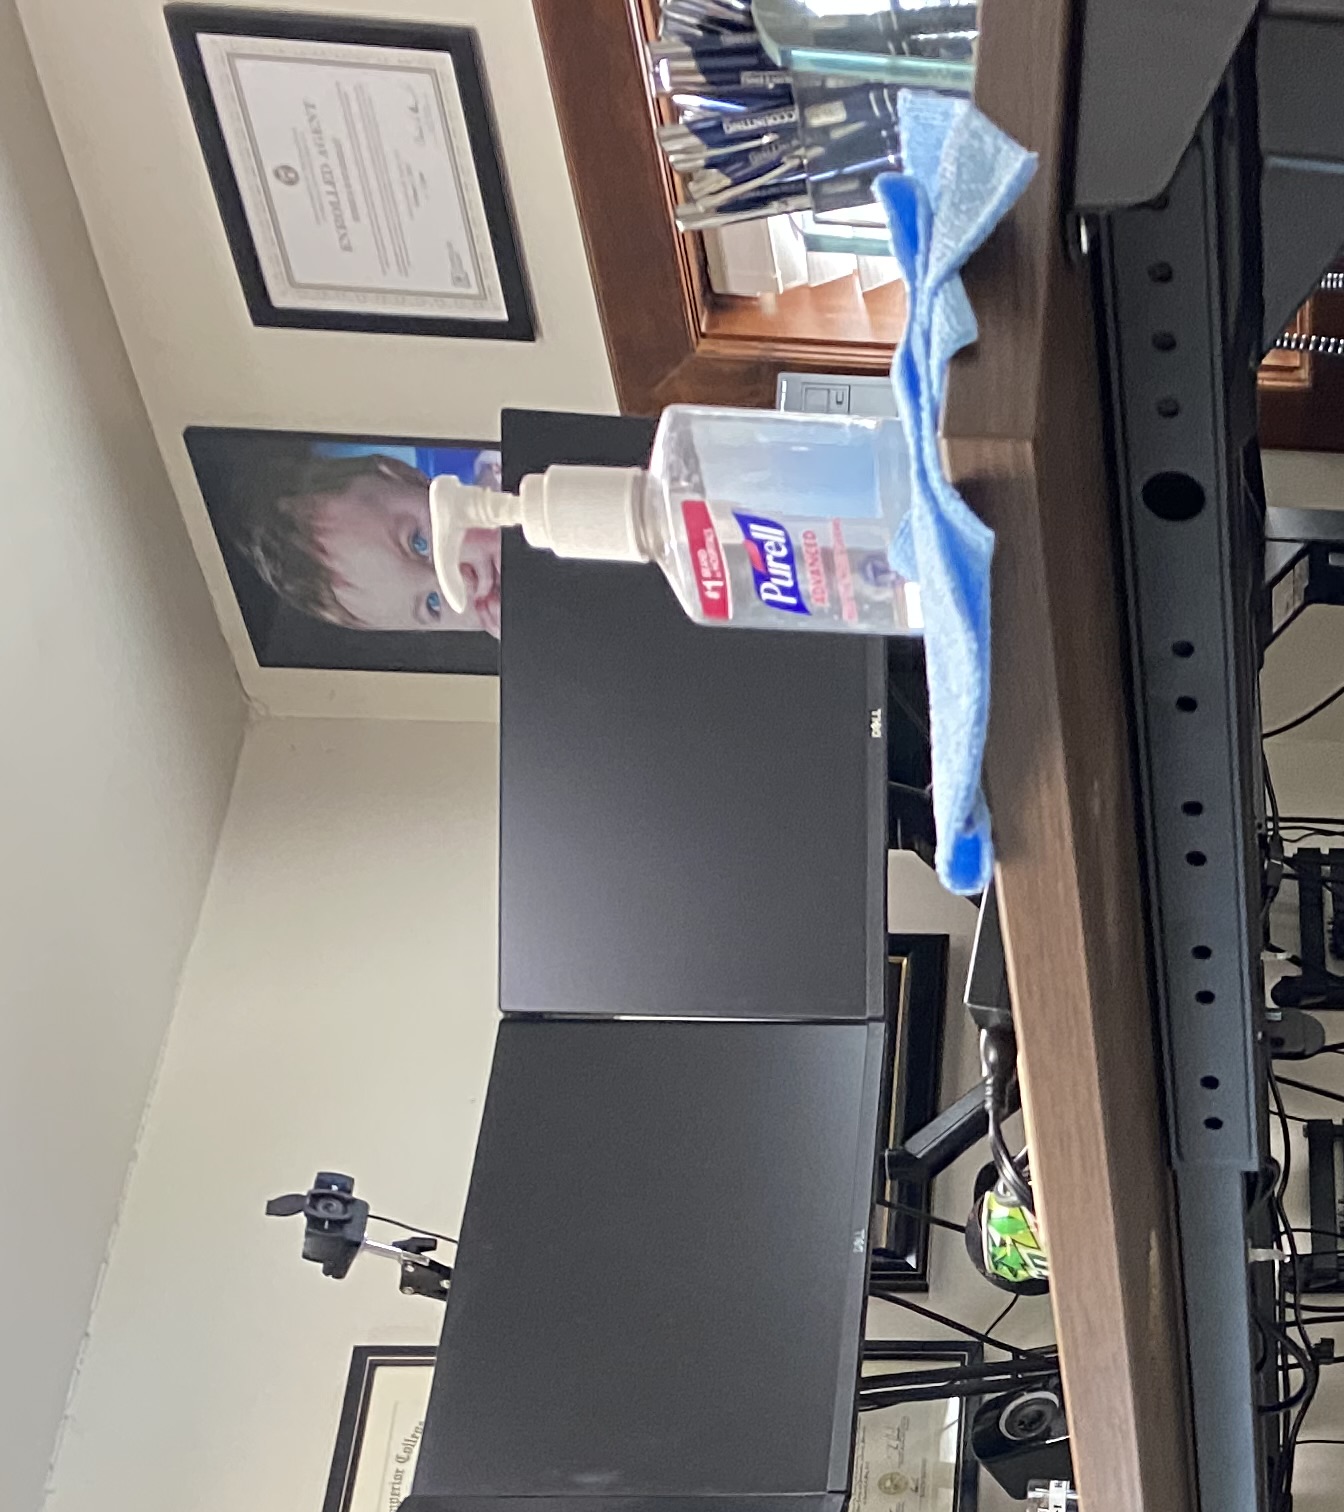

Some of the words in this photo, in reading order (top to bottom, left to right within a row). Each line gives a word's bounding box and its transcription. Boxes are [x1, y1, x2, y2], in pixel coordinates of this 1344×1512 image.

[302, 97, 329, 159] AGENT
[320, 162, 353, 253] ENROLLED
[749, 523, 798, 605] Purell
[802, 530, 827, 605] ADVANCED
[870, 708, 882, 738] DELL
